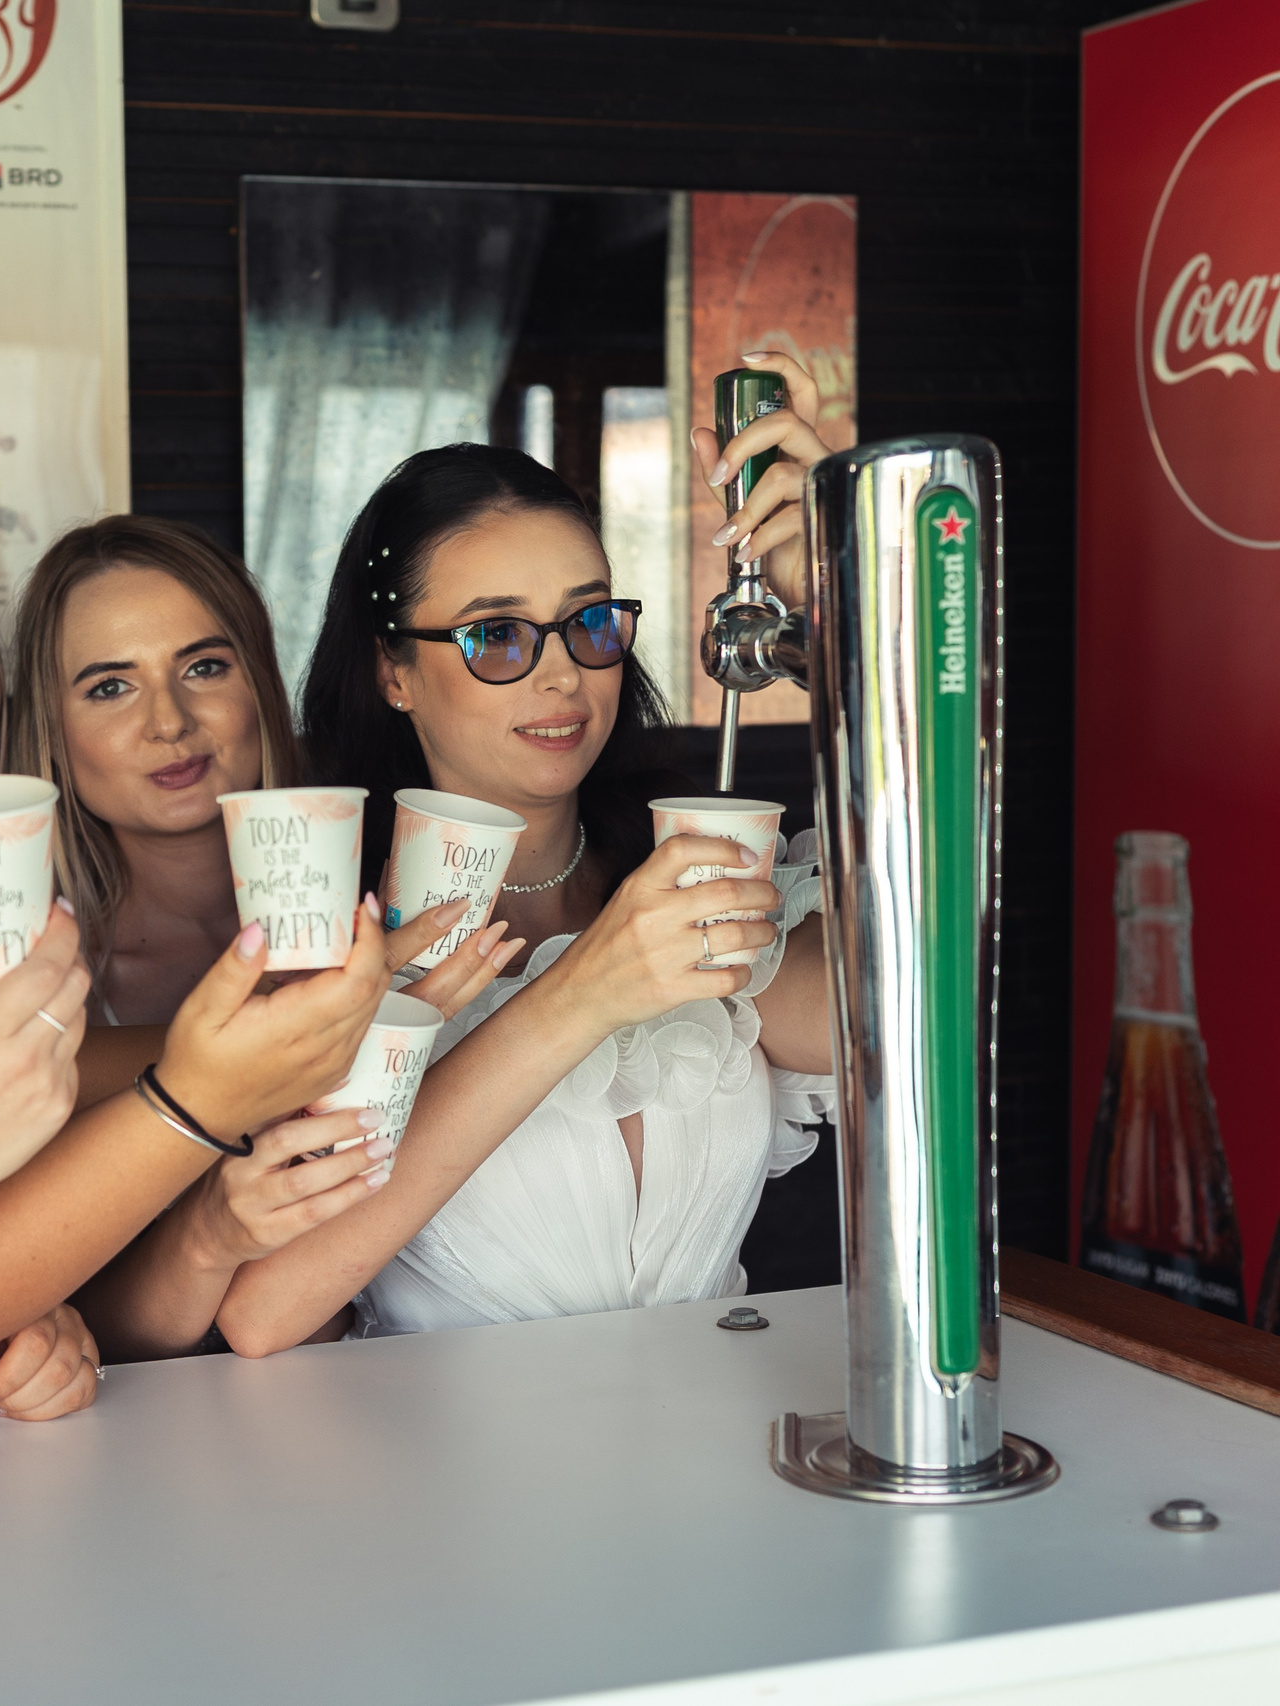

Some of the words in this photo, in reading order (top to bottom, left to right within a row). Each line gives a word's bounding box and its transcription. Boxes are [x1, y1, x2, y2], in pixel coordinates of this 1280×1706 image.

[7, 166, 63, 187] BRD
[938, 551, 966, 695] Heineken
[247, 813, 311, 848] TODAY
[263, 848, 277, 866] IS
[280, 848, 301, 866] THE
[442, 840, 501, 872] TODAY
[248, 869, 296, 900] perfect
[300, 864, 330, 891] day
[450, 872, 463, 886] IS
[466, 874, 484, 889] THE
[279, 893, 293, 908] TO
[295, 891, 308, 908] BE
[475, 889, 493, 910] day
[466, 911, 477, 924] BE
[255, 909, 334, 950] HAPPY
[391, 1077, 402, 1091] IS
